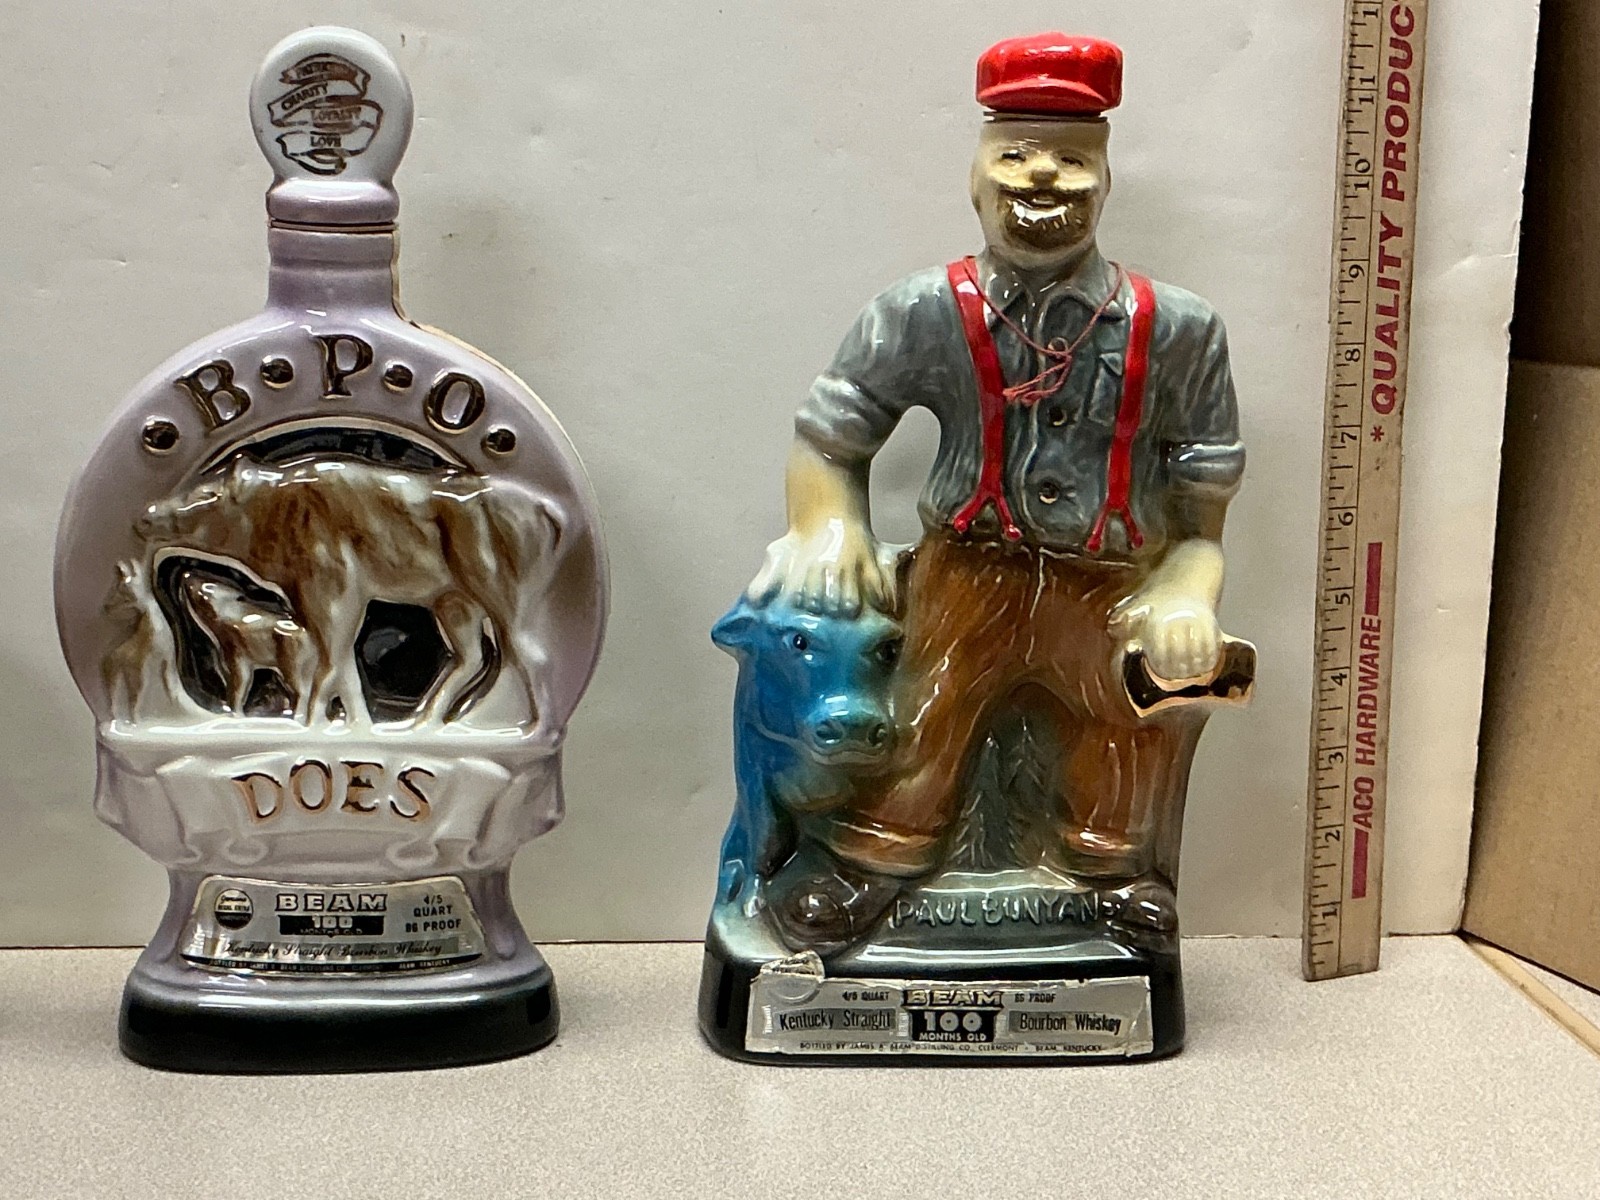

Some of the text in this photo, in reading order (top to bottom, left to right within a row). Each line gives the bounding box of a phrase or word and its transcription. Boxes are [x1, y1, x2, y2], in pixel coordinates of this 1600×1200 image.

[281, 82, 328, 110] CHARITY
[310, 135, 341, 148] LOVE
[1371, 1, 1415, 414] QUALITY PRODUC
[1349, 264, 1365, 279] 9
[1344, 348, 1361, 362] 8
[1341, 431, 1357, 443] 7
[1338, 511, 1354, 526] 6
[1335, 592, 1350, 605] 5
[1331, 671, 1347, 686] 4
[1353, 616, 1381, 829] ACO HARDWARE
[1328, 751, 1344, 764] 3
[231, 759, 435, 824] DOES
[1324, 829, 1340, 842] 2
[275, 893, 388, 912] BEAM
[423, 895, 443, 906] 4/5
[413, 905, 453, 918] QUART
[892, 891, 1099, 928] PAUL BUNYAN
[1321, 907, 1338, 920] 1
[312, 914, 353, 929] 100
[423, 919, 462, 932] PROOF
[225, 941, 278, 957] Kentucky
[394, 941, 442, 956] Whiskey
[861, 991, 890, 1002] QUART
[902, 988, 1004, 1008] BEAM
[1029, 993, 1056, 1003] PROOF
[780, 1009, 891, 1030] Kentucky Straight
[924, 1011, 982, 1032] 100
[1020, 1013, 1121, 1035] Bourbon Whiskey
[920, 1032, 987, 1041] MONTHS OLD
[978, 1043, 1018, 1052] CLERMONT
[1063, 1045, 1102, 1053] KENTUCKY
